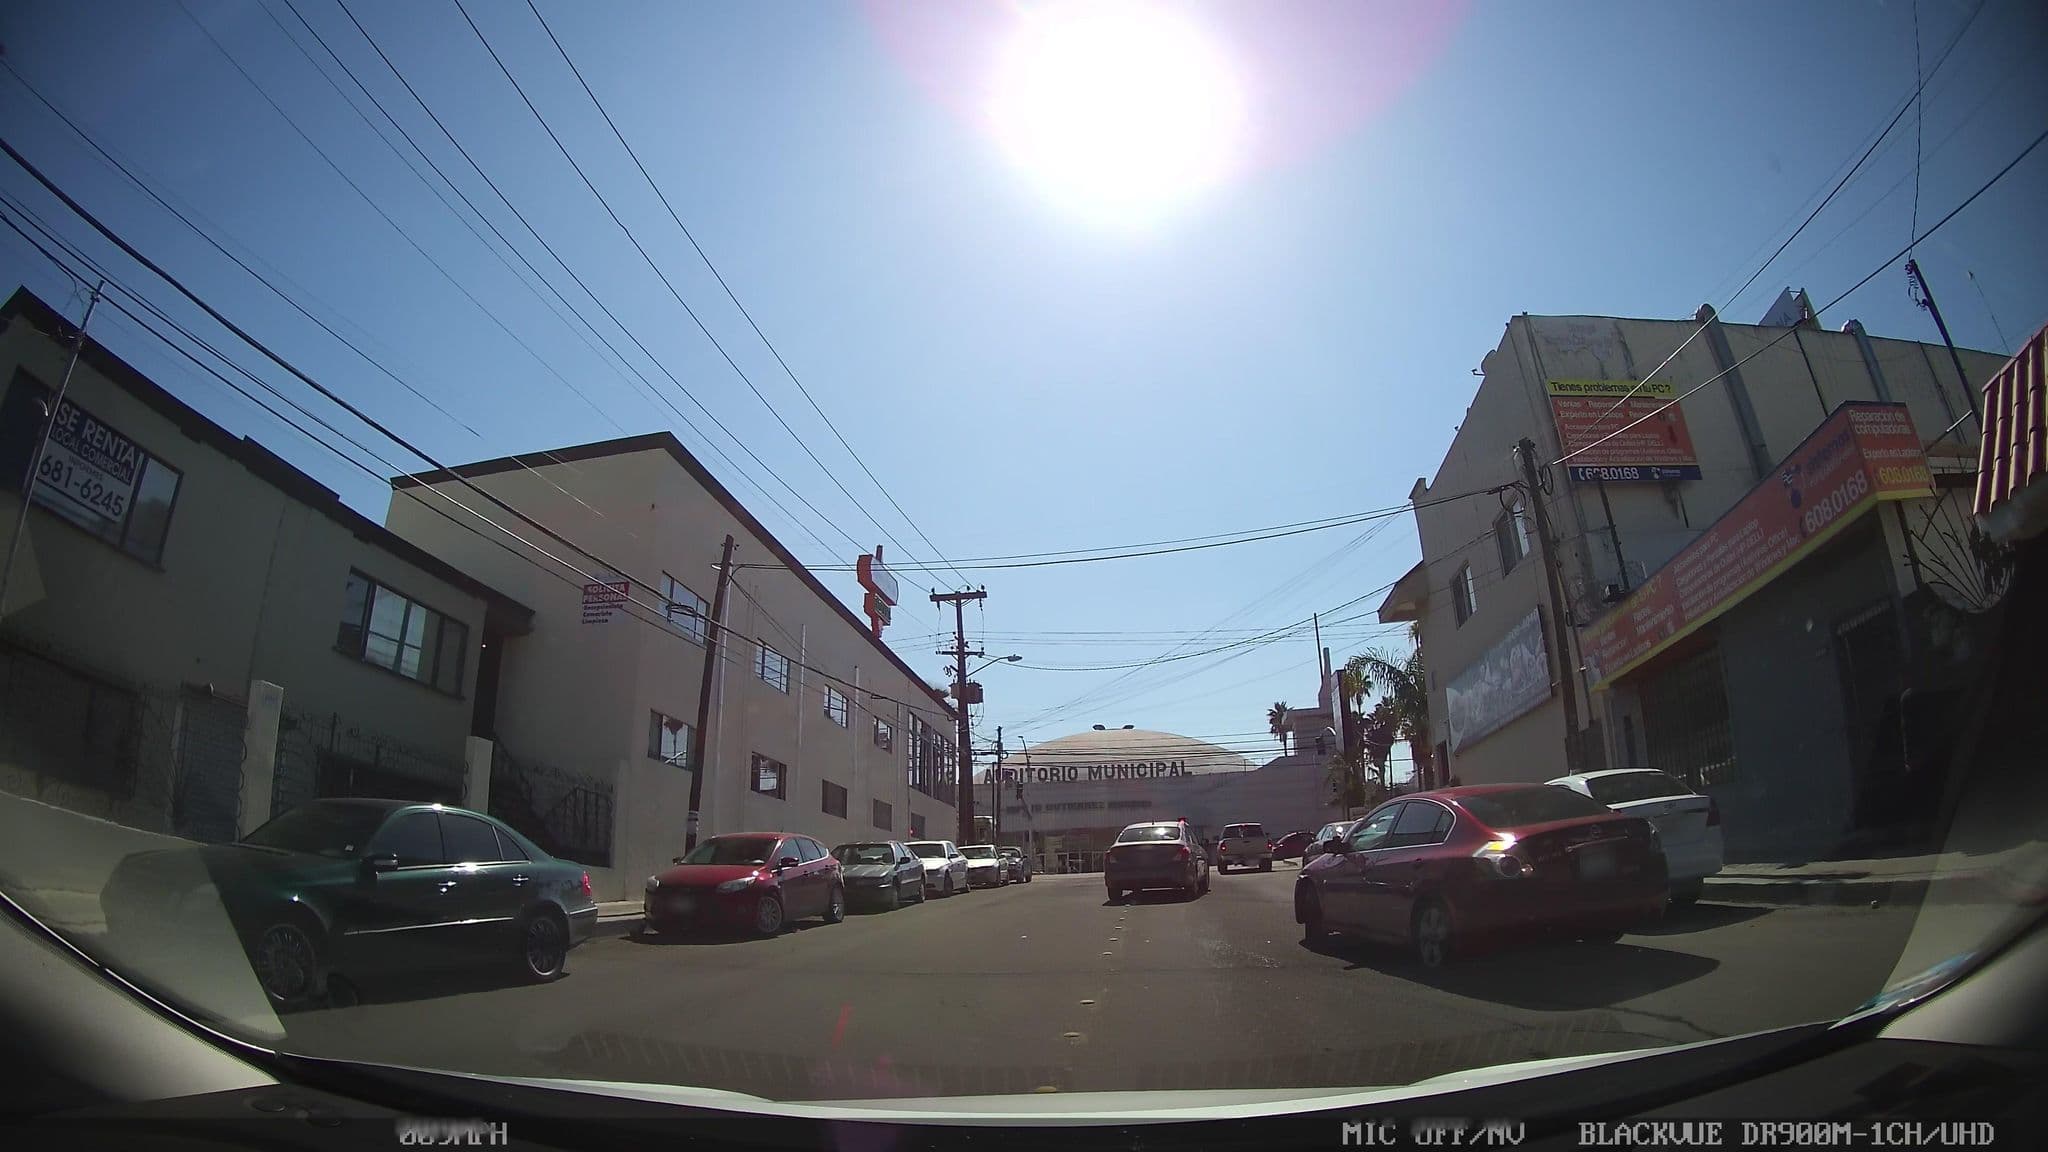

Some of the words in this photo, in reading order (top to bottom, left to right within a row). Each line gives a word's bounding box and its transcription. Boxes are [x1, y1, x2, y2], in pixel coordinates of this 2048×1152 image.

[1551, 382, 1583, 393] Tienes
[1584, 382, 1630, 394] problemas
[51, 427, 80, 455] LOCAL
[81, 443, 132, 482] COMERCIAL
[56, 403, 81, 433] SE
[82, 418, 136, 470] RENTA
[40, 455, 125, 517] 681-6245
[1805, 469, 1868, 533] 608.0168
[584, 592, 628, 604] PERSONAL
[984, 764, 1079, 785] AUDITORIO
[1087, 760, 1193, 784] MUNICIPAL
